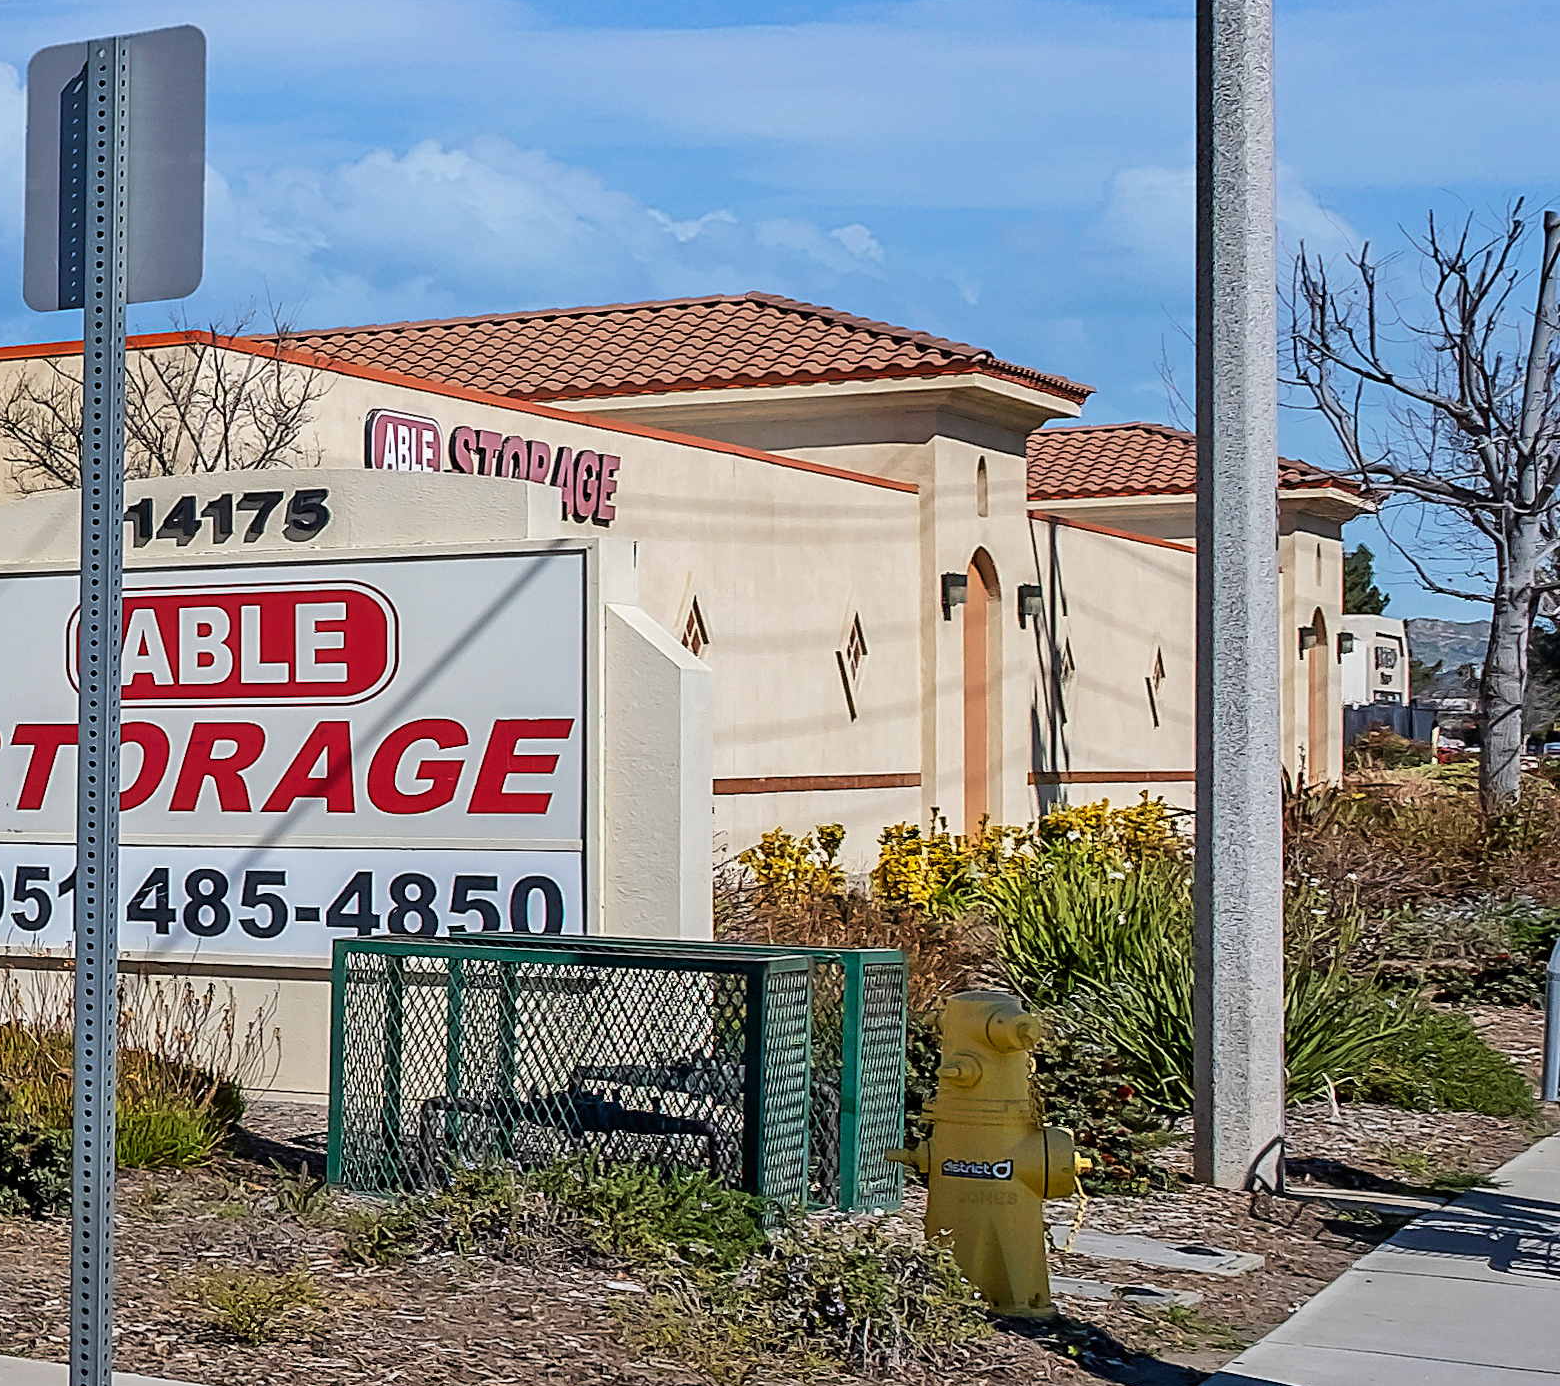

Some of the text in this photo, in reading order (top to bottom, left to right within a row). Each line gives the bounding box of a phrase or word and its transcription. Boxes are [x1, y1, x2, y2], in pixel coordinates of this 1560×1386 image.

[383, 422, 621, 525] ABLE STORAGE
[123, 489, 331, 547] 14175
[121, 602, 348, 686] ABLE
[126, 867, 564, 939] 485-4850
